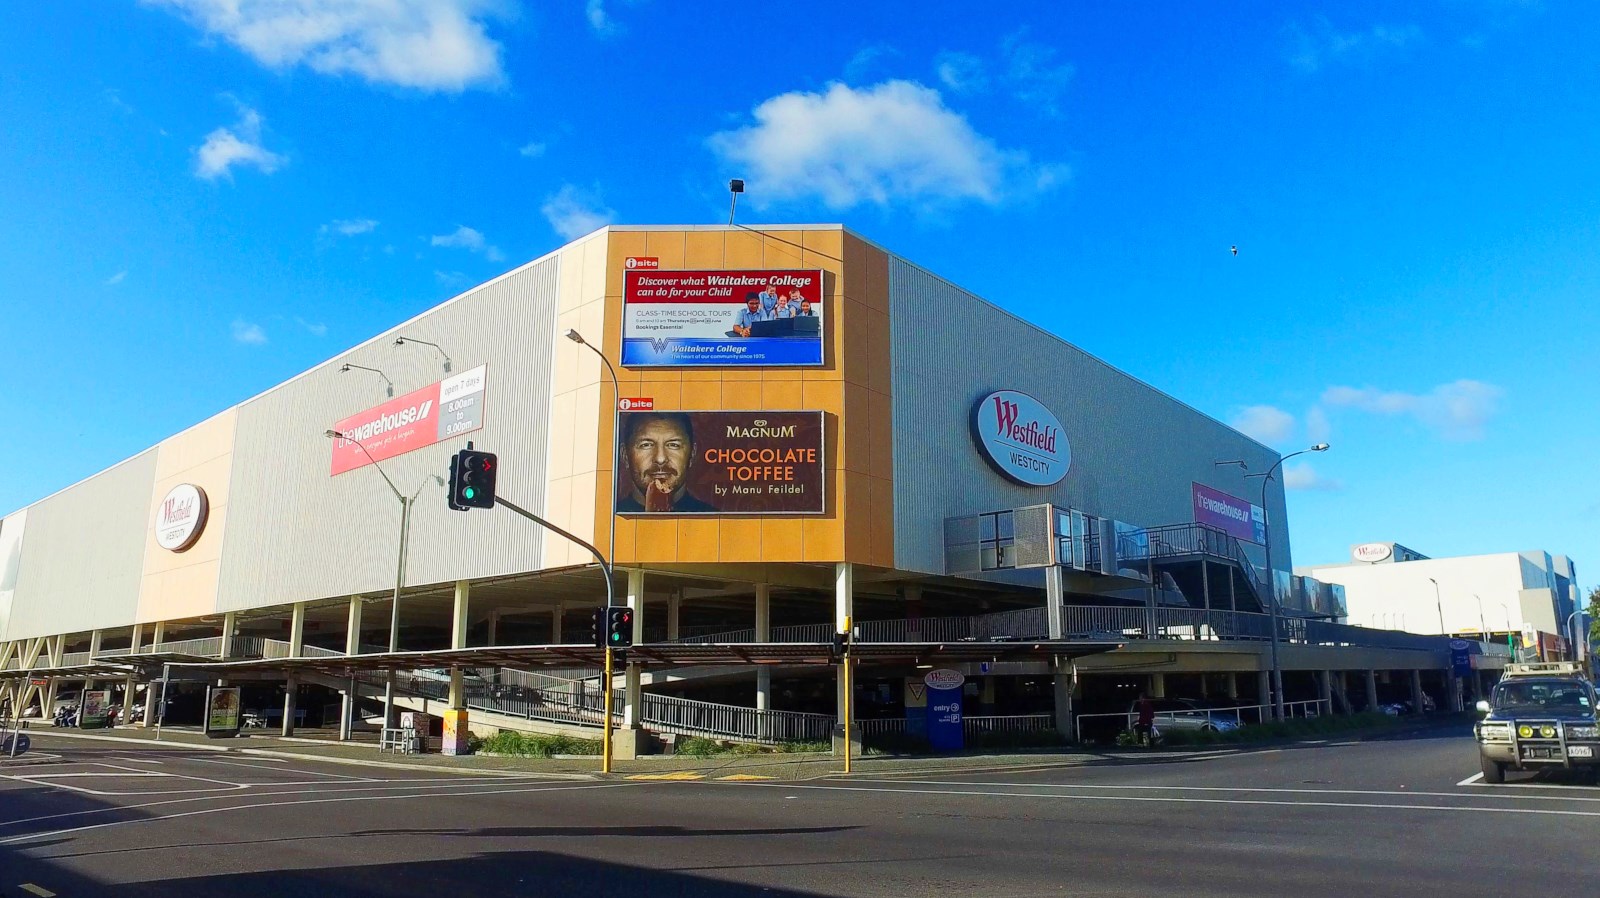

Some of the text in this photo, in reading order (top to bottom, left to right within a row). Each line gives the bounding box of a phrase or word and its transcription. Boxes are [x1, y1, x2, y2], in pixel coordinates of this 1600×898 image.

[638, 276, 812, 288] Discover what Waitakere College
[656, 288, 667, 296] do
[668, 288, 683, 298] for
[683, 290, 706, 298] your
[708, 288, 732, 296] Child
[717, 345, 747, 354] College
[445, 376, 480, 396] open 7 days
[448, 398, 474, 413] 8.00am
[456, 411, 464, 420] to
[446, 420, 473, 435] 9.00pm
[726, 426, 795, 438] MAGNUM
[993, 396, 1057, 454] Westfield
[705, 448, 816, 463] CHOCOLATE
[1010, 452, 1050, 475] WESTCITY
[727, 466, 793, 481] TOFFEE
[715, 485, 804, 496] by Manu Feildel
